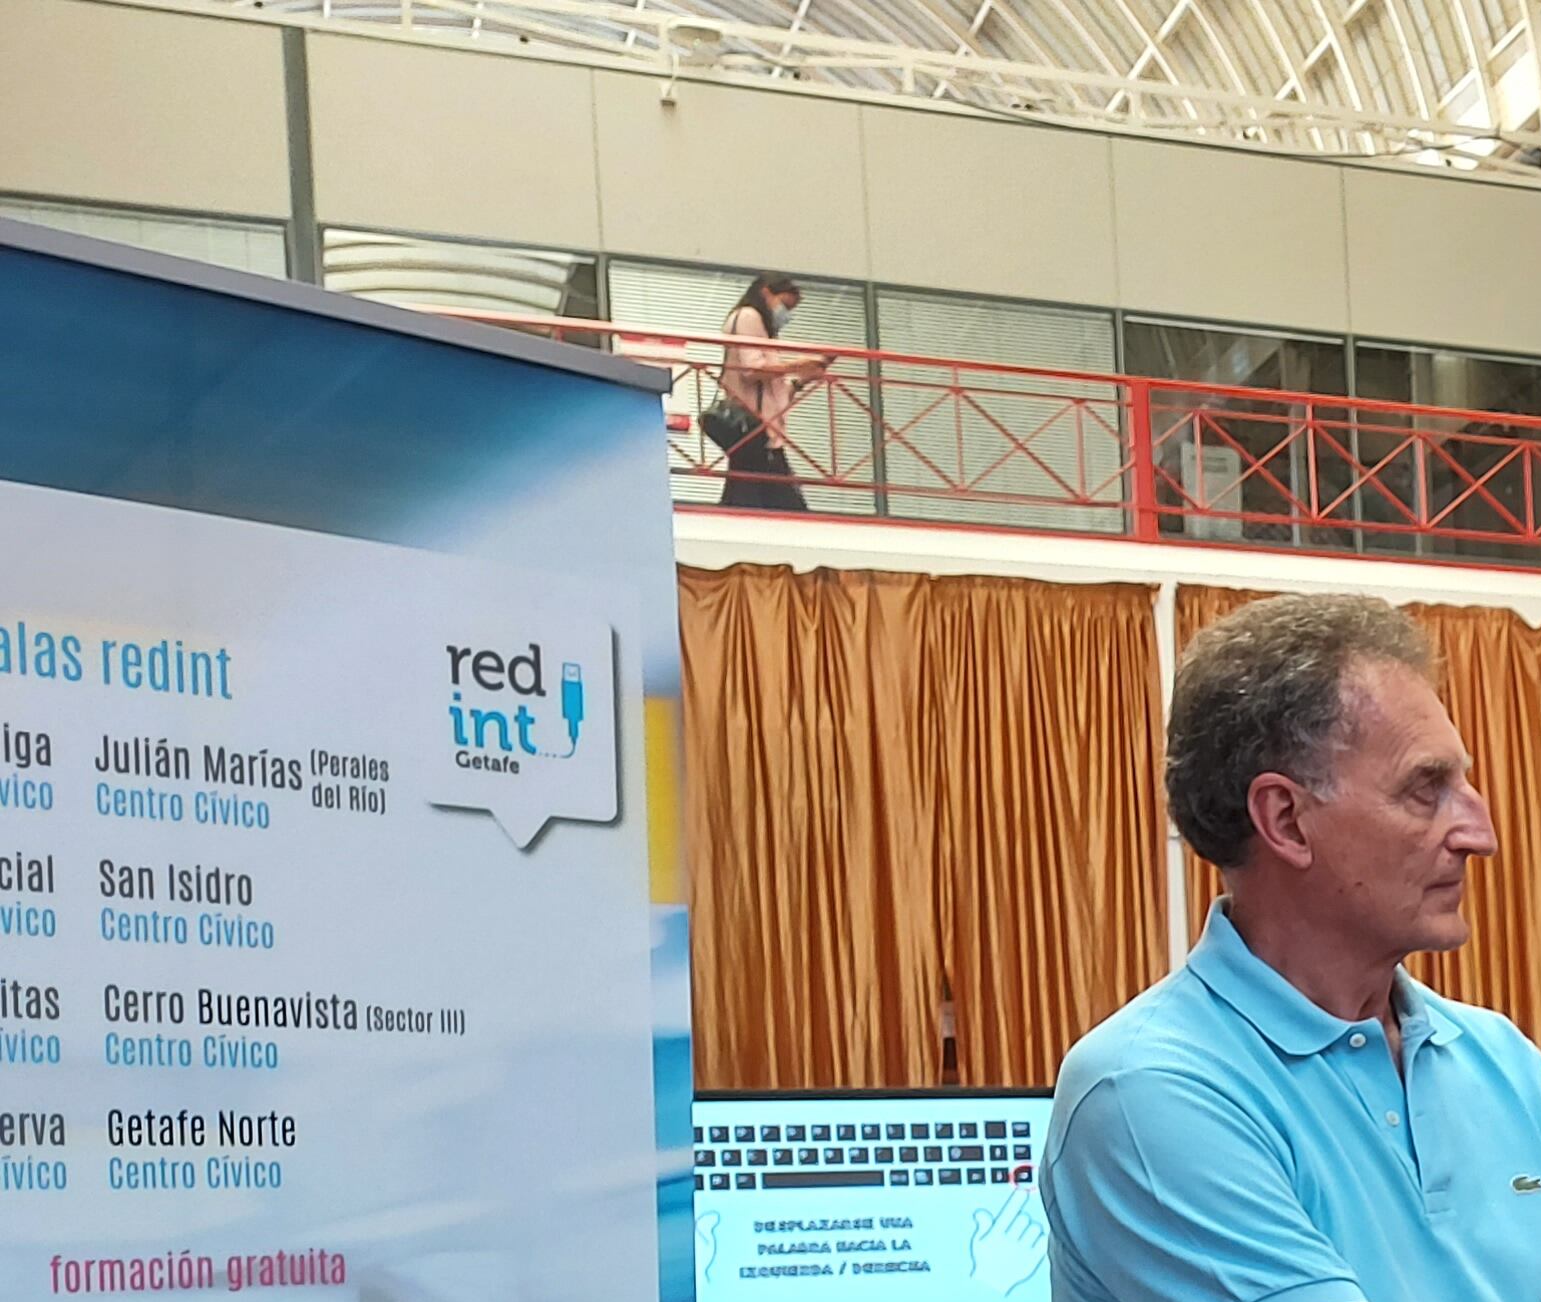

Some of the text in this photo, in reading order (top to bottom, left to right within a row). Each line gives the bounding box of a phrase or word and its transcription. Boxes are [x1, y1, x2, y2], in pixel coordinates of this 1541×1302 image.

[101, 638, 232, 699] redint
[447, 643, 546, 697] red
[449, 692, 537, 755] int
[3, 722, 52, 769] iga
[95, 734, 303, 791] Julián Marías
[310, 749, 390, 783] (Perales
[455, 750, 520, 775] Getafe
[96, 782, 270, 829] Centro Cívico
[312, 784, 386, 815] del Río)
[99, 859, 253, 906] San Isidro
[100, 907, 274, 949] Centro Cívico
[104, 984, 466, 1035] Cerro Buenavista (Sector III)
[105, 1032, 278, 1069] Centro Cívico
[107, 1108, 296, 1147] Getafe Norte
[108, 1155, 282, 1190] Centro Cívico
[879, 1217, 913, 1229] UNA
[757, 1239, 912, 1256] PALABRA HACIA LA
[852, 1260, 931, 1275] DERECHA
[50, 1248, 346, 1294] formación gratuita
